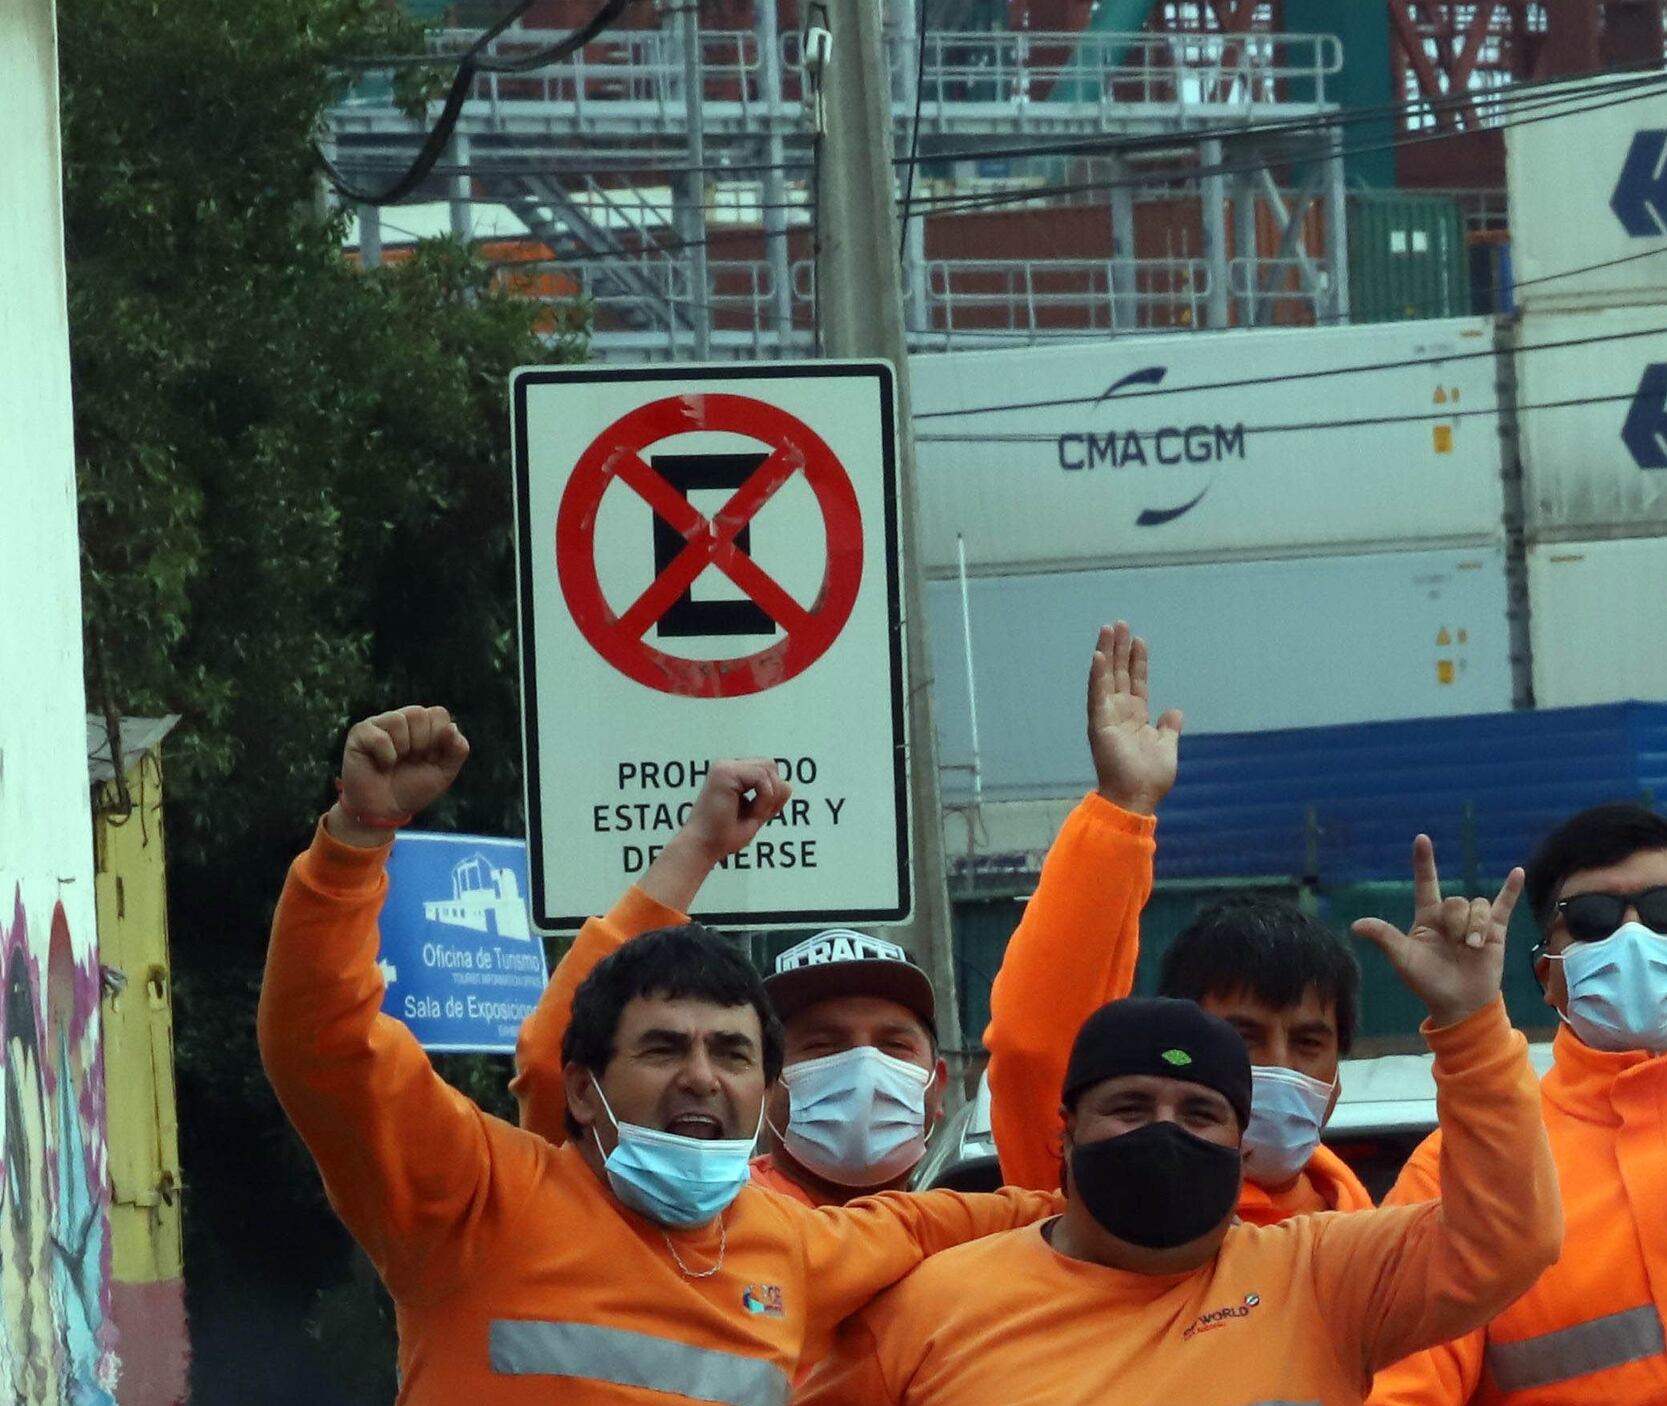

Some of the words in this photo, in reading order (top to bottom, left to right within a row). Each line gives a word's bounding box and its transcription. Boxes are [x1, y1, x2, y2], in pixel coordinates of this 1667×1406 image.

[1058, 430, 1147, 470] CMA
[1155, 423, 1245, 464] CGM
[618, 757, 817, 790] PROHDO
[593, 799, 810, 832] ESTACAR
[825, 798, 846, 825] Y
[423, 943, 472, 968] Oficina
[476, 947, 492, 969] de
[494, 947, 540, 972] Turismo
[404, 996, 440, 1018] Sala
[446, 997, 464, 1018] de
[1199, 1306, 1249, 1325] WORLD
